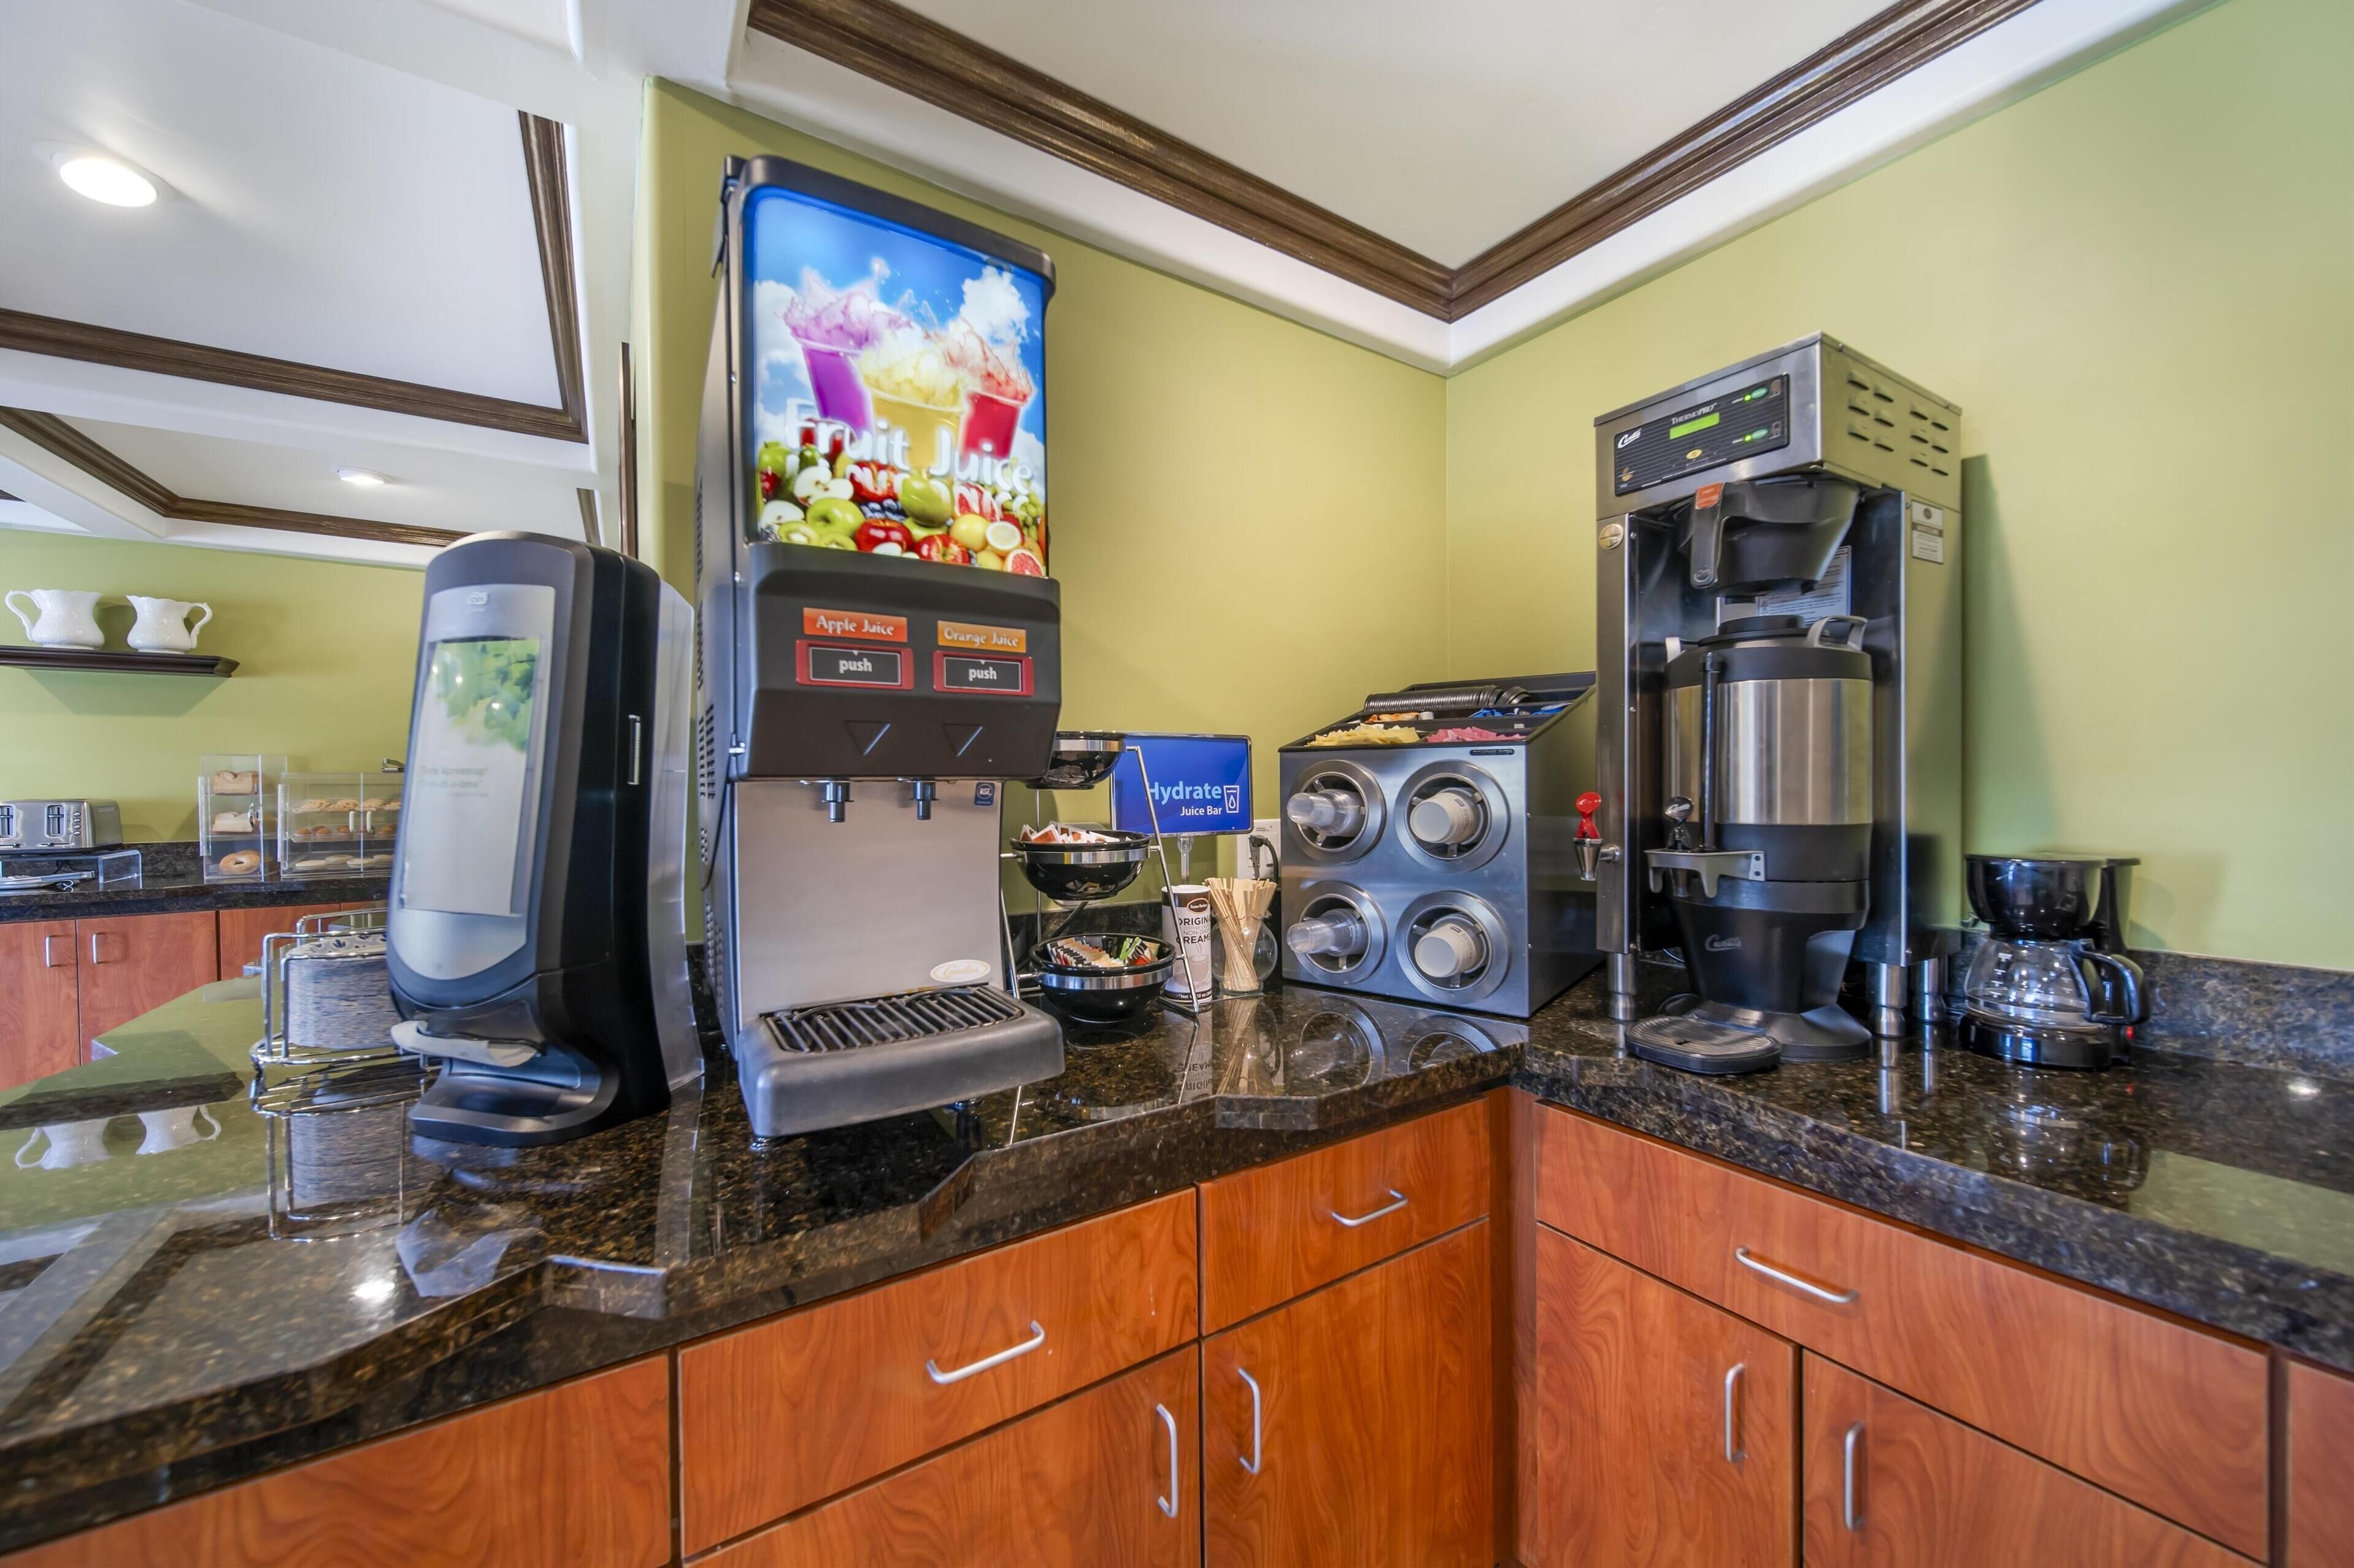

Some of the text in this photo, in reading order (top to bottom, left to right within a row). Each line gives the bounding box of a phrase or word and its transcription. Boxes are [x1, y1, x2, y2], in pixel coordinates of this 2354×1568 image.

[786, 398, 1032, 494] Fruit Juice
[816, 615, 894, 636] Apple Juice
[944, 628, 1018, 647] Orange Juice
[839, 658, 872, 674] push
[969, 667, 997, 681] push
[1146, 781, 1222, 805] Hydrate
[1180, 805, 1222, 816] Juice Bar
